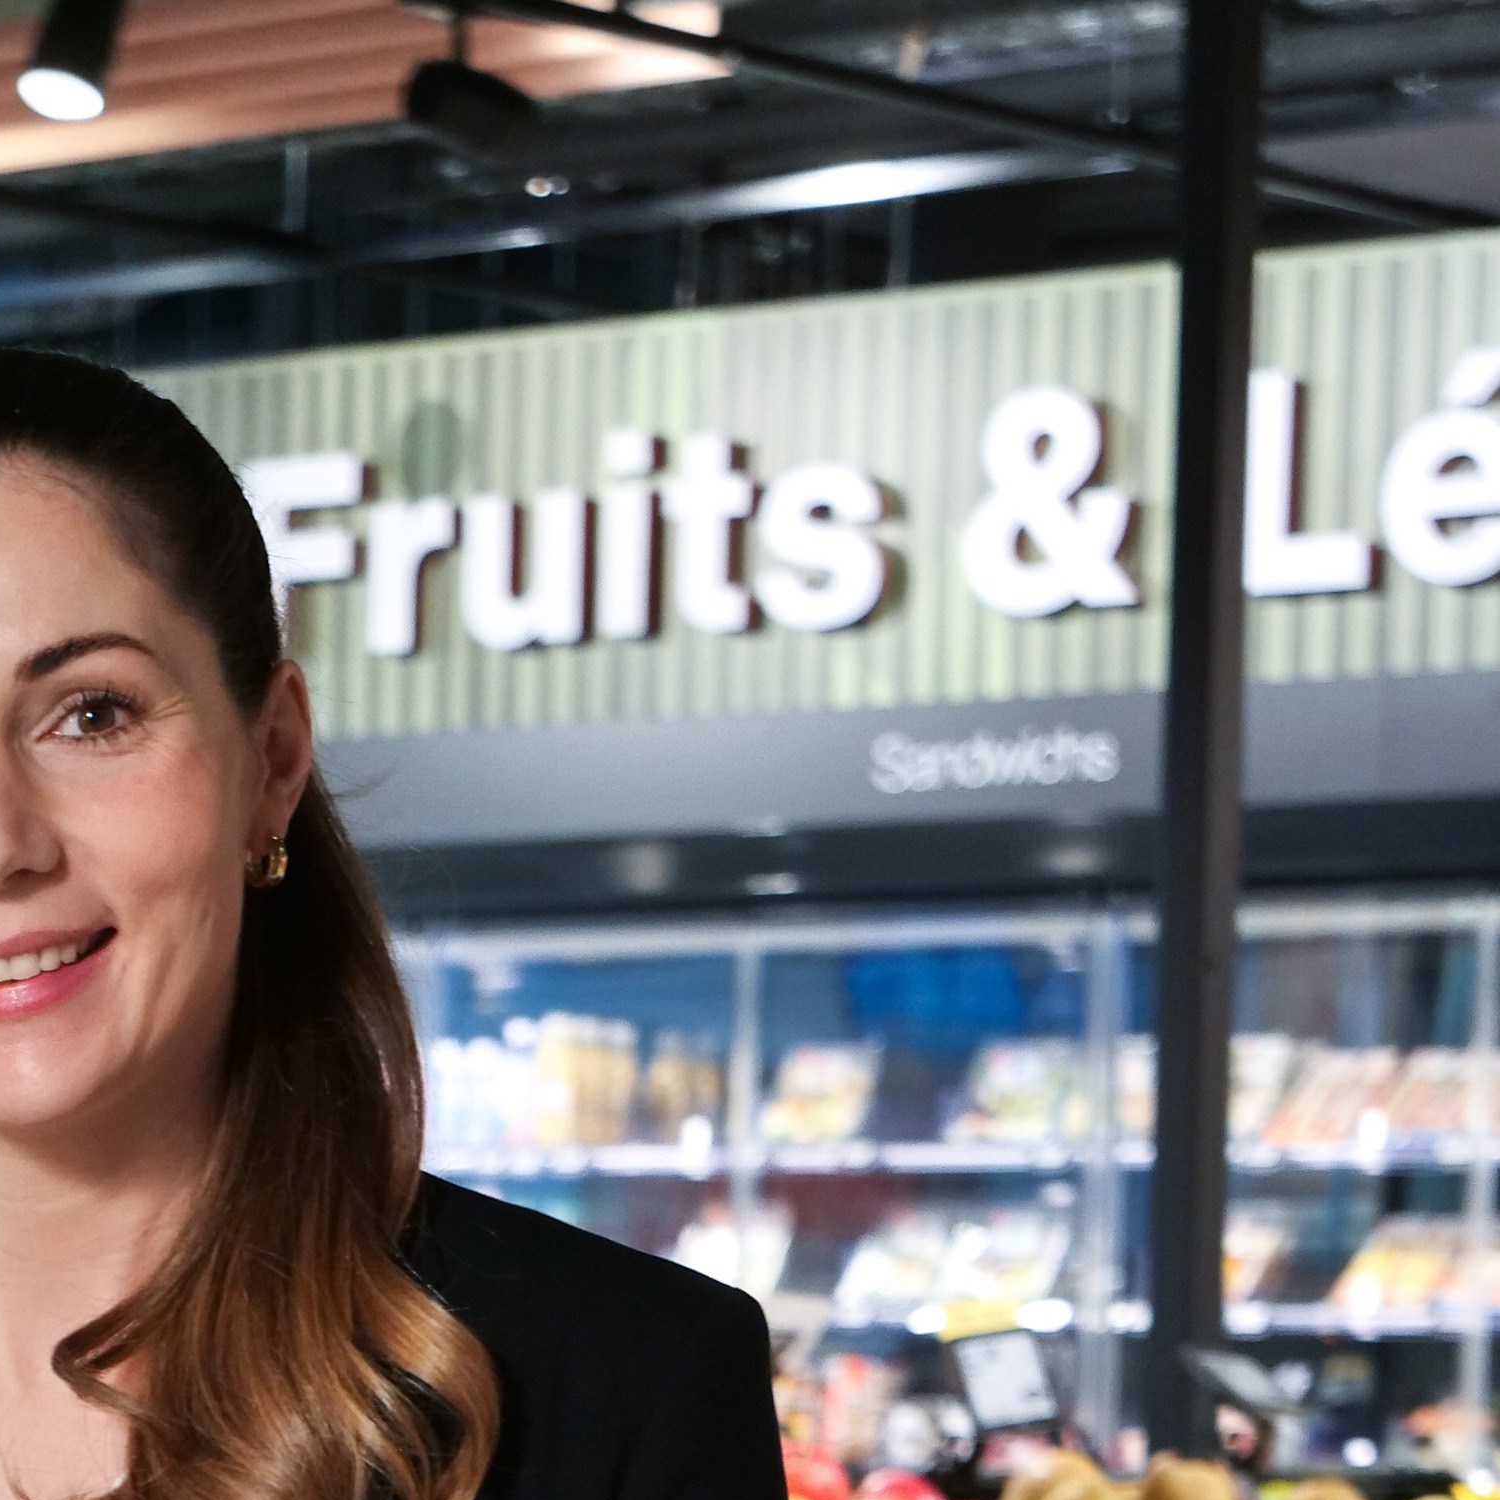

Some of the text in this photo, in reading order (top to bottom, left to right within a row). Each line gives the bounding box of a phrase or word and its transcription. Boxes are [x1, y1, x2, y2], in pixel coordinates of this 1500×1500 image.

[243, 346, 1500, 656] Fruits & Lé
[869, 728, 1120, 794] Sandwichs
